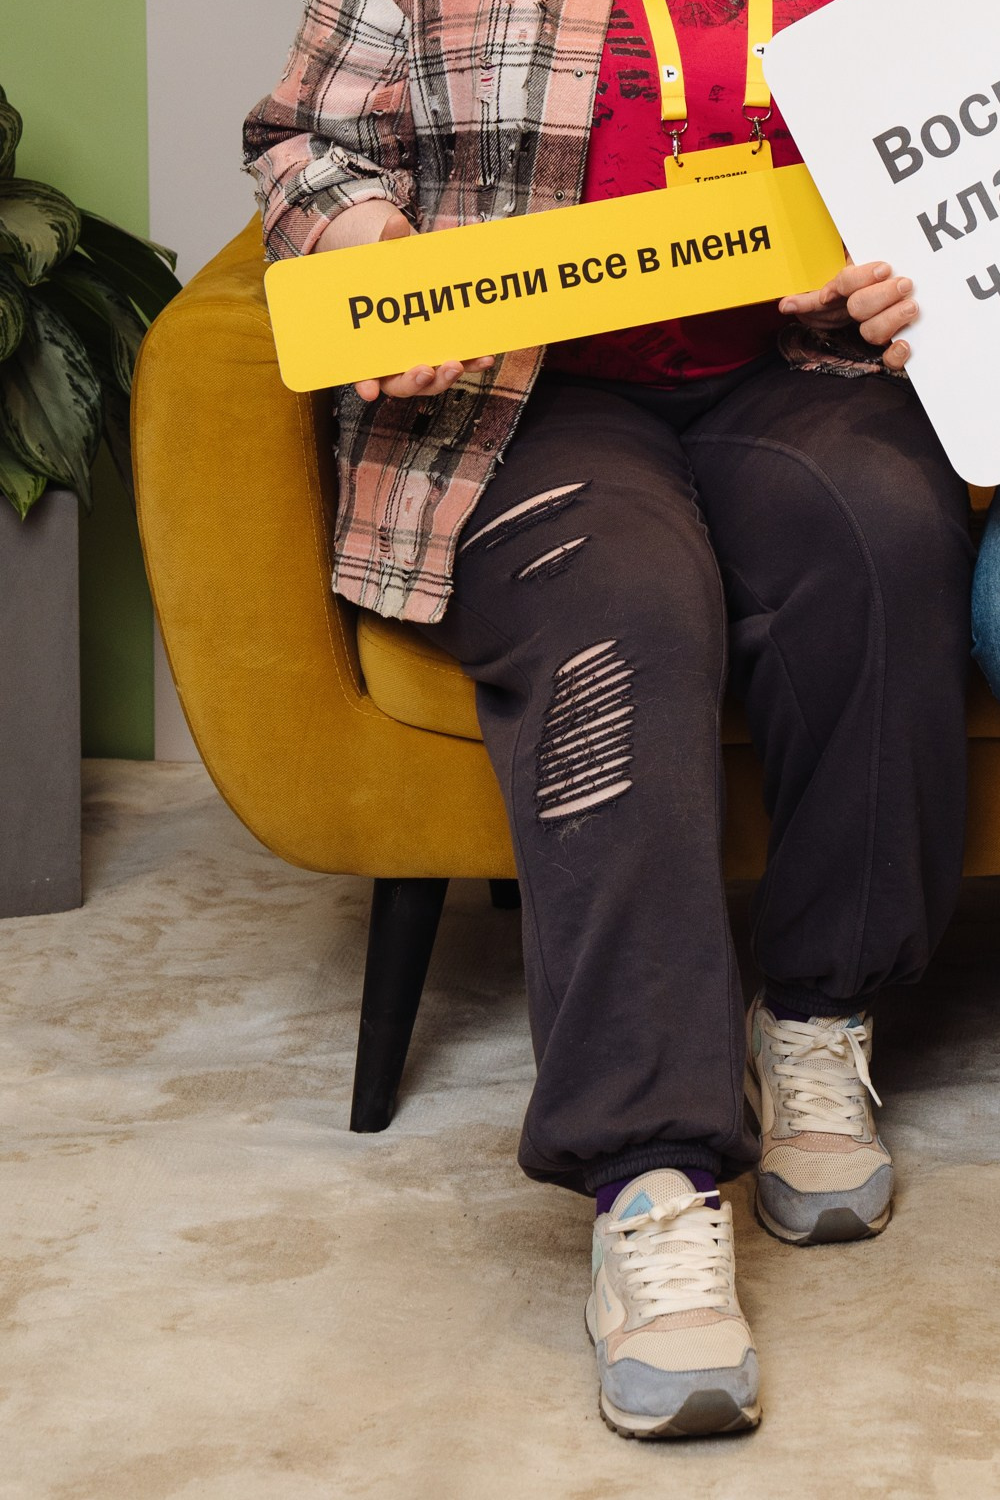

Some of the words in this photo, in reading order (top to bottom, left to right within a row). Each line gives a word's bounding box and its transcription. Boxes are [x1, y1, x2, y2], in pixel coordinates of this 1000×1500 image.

[348, 267, 548, 330] Родители
[557, 253, 628, 289] все
[636, 247, 661, 274] в
[670, 225, 771, 268] меня
